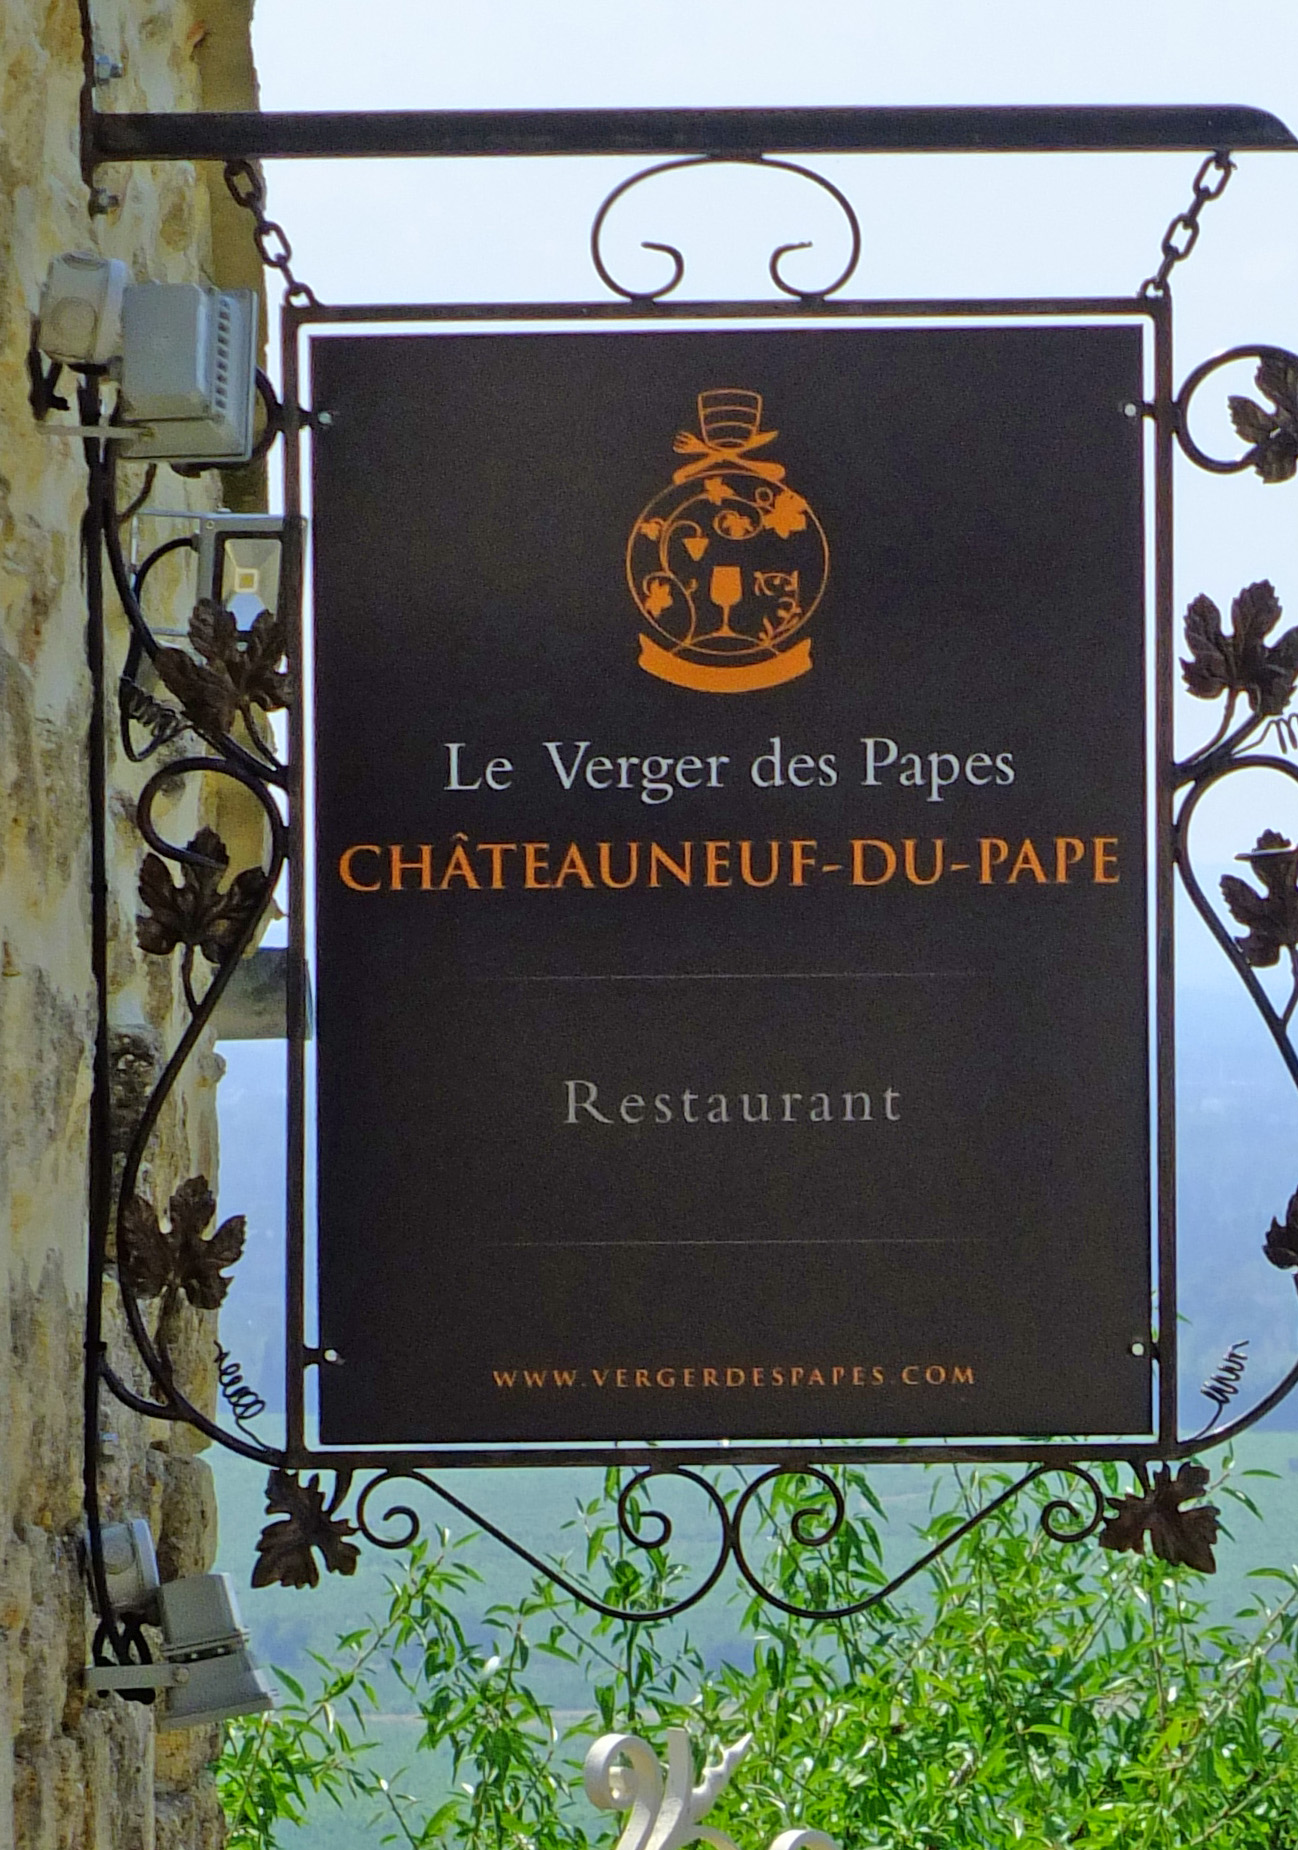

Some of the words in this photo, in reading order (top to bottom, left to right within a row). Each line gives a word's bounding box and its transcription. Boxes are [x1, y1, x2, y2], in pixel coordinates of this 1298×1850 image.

[444, 741, 514, 791] Le
[542, 740, 730, 805] Verger
[751, 736, 838, 788] des
[860, 736, 1016, 802] Papes
[339, 832, 1121, 892] CHÂTEAUNEUF-DU-PAPE
[562, 1079, 902, 1125] Restaurant
